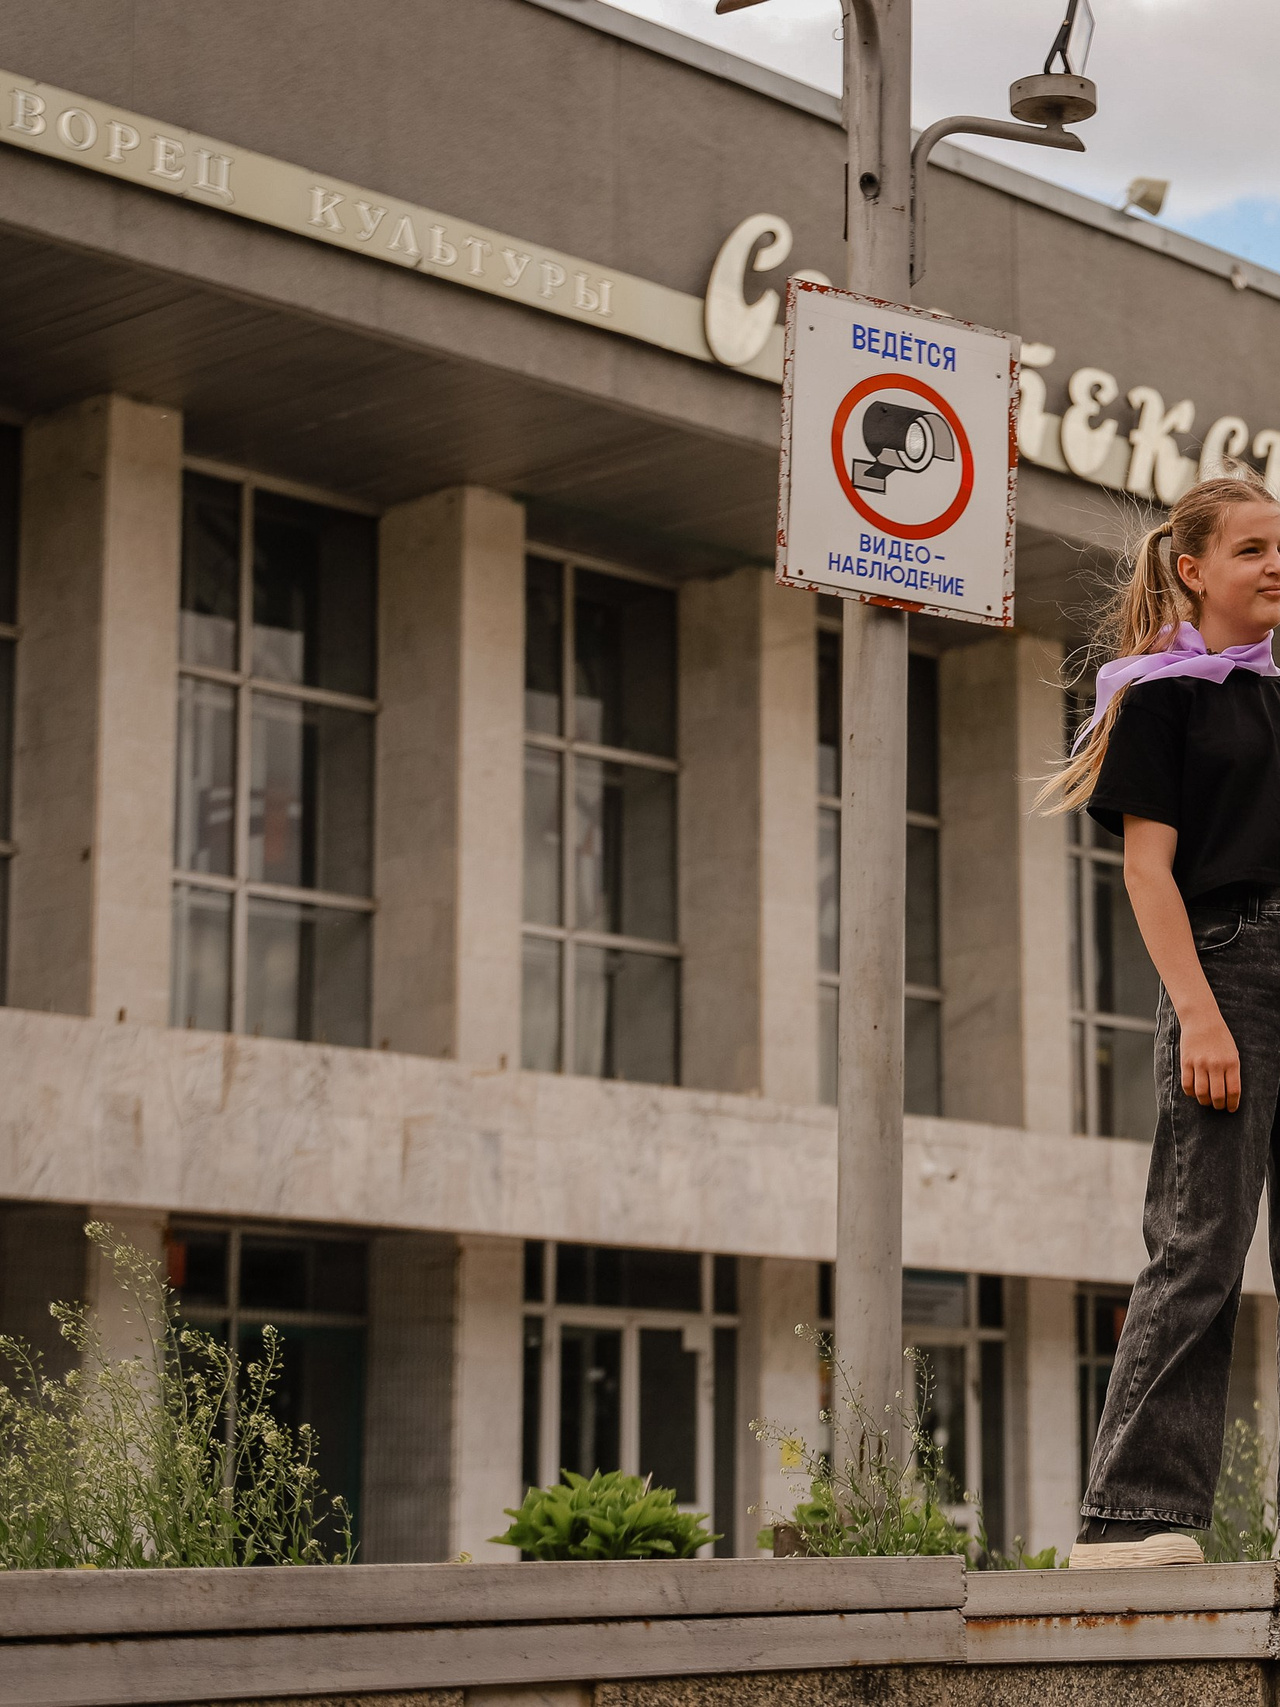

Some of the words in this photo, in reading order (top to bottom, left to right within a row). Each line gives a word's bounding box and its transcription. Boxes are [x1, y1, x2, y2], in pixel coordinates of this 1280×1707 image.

[0, 88, 236, 205] ВОРЕЦ
[307, 185, 613, 317] КУЛЬТУРЫ
[852, 323, 956, 372] ВЕДЁТСЯ
[859, 533, 946, 564] ВИДЕО-
[828, 552, 965, 597] НАБЛЮДЕНИЕ
